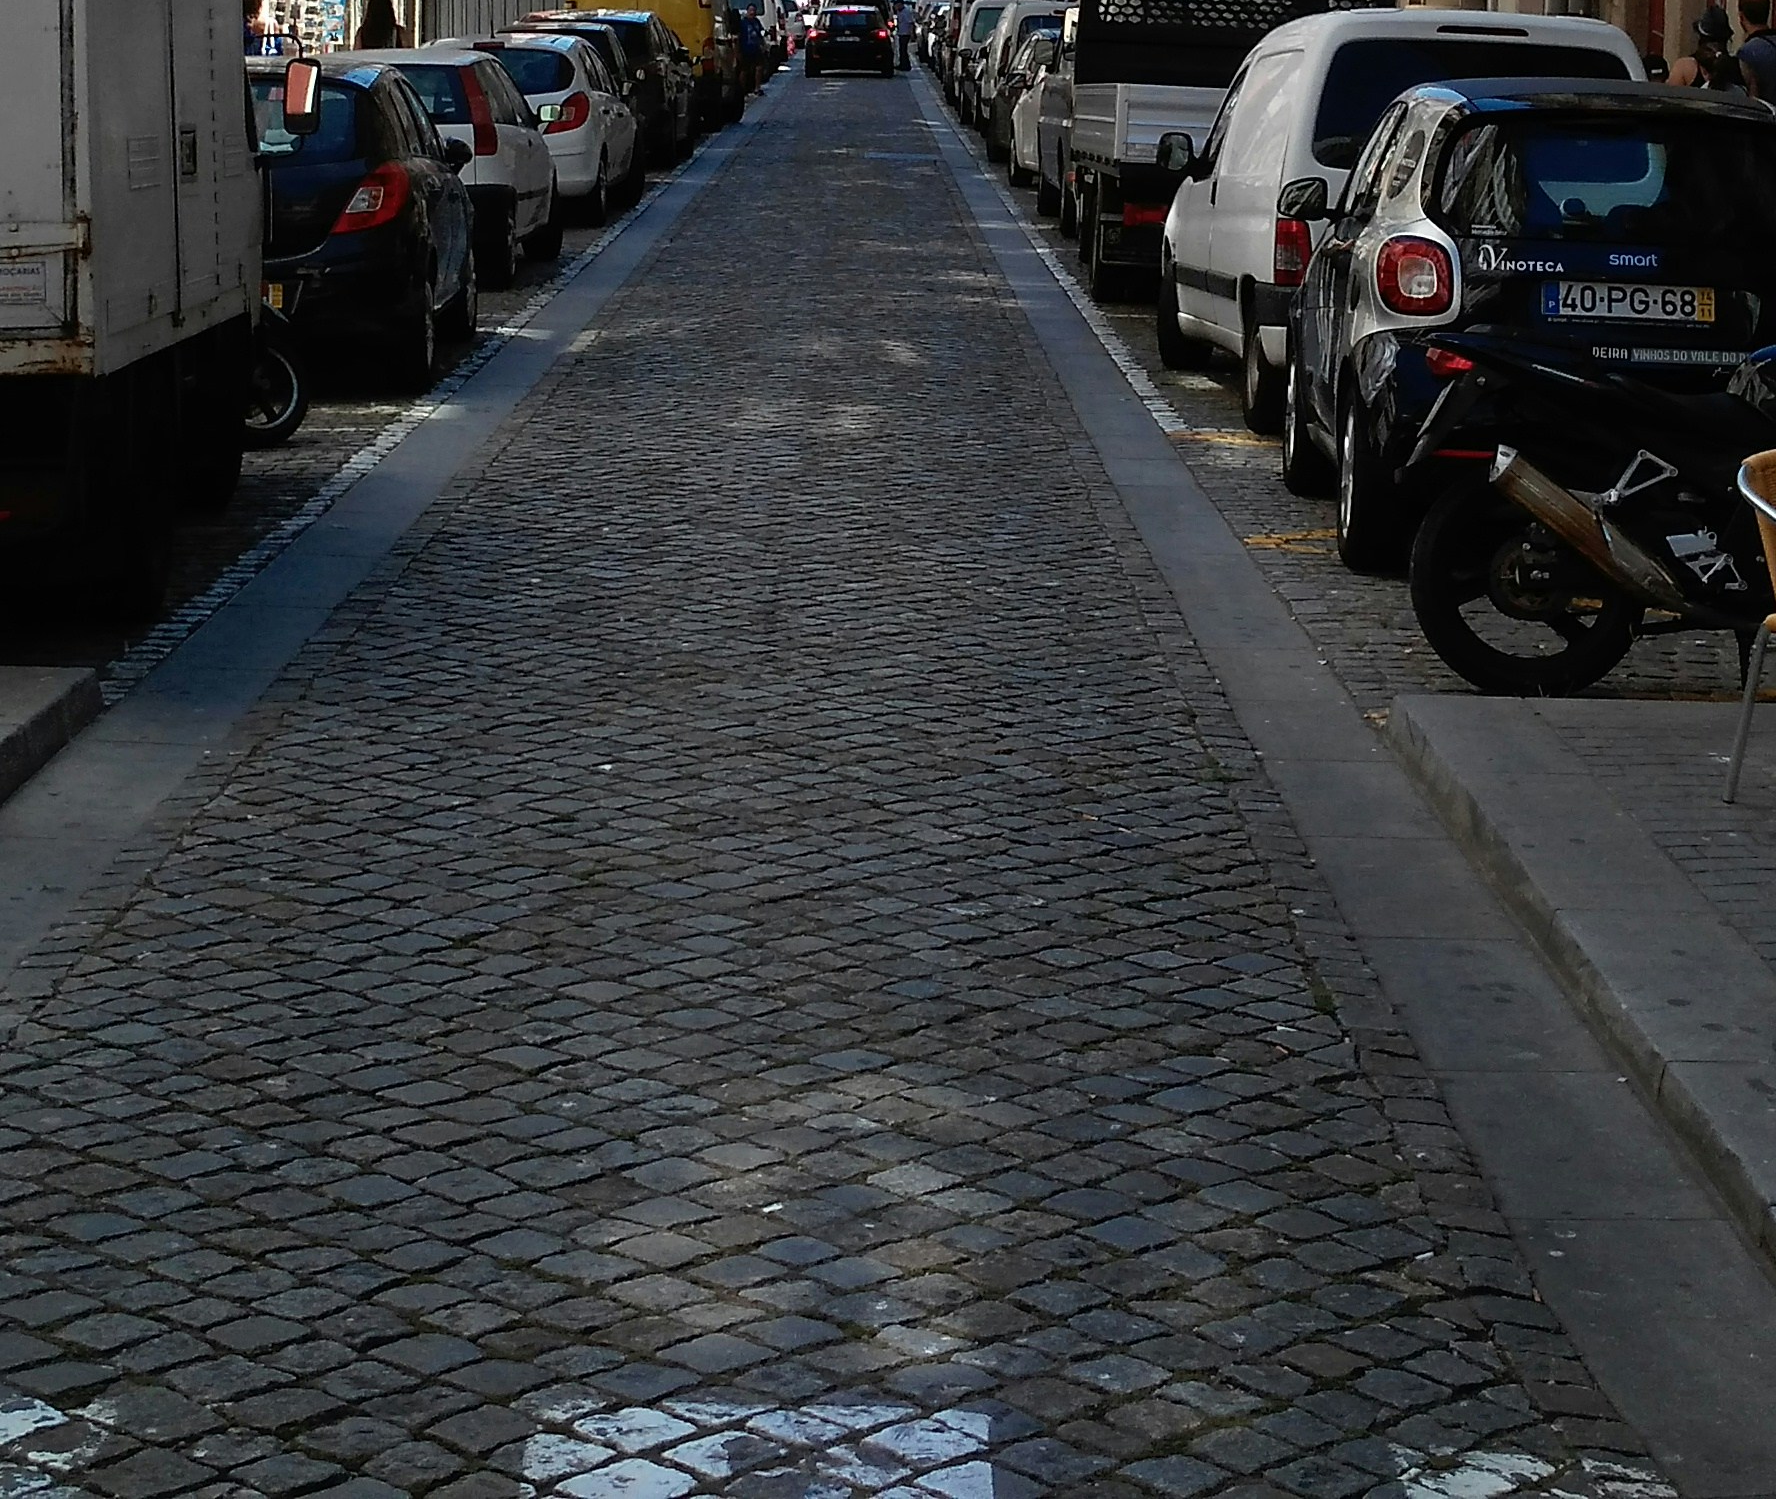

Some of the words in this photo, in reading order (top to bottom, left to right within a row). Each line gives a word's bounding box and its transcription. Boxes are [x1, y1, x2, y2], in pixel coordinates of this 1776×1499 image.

[1608, 252, 1659, 268] smart
[1632, 348, 1670, 362] VINHOS
[1673, 349, 1687, 362] DO
[1691, 350, 1720, 363] VALE
